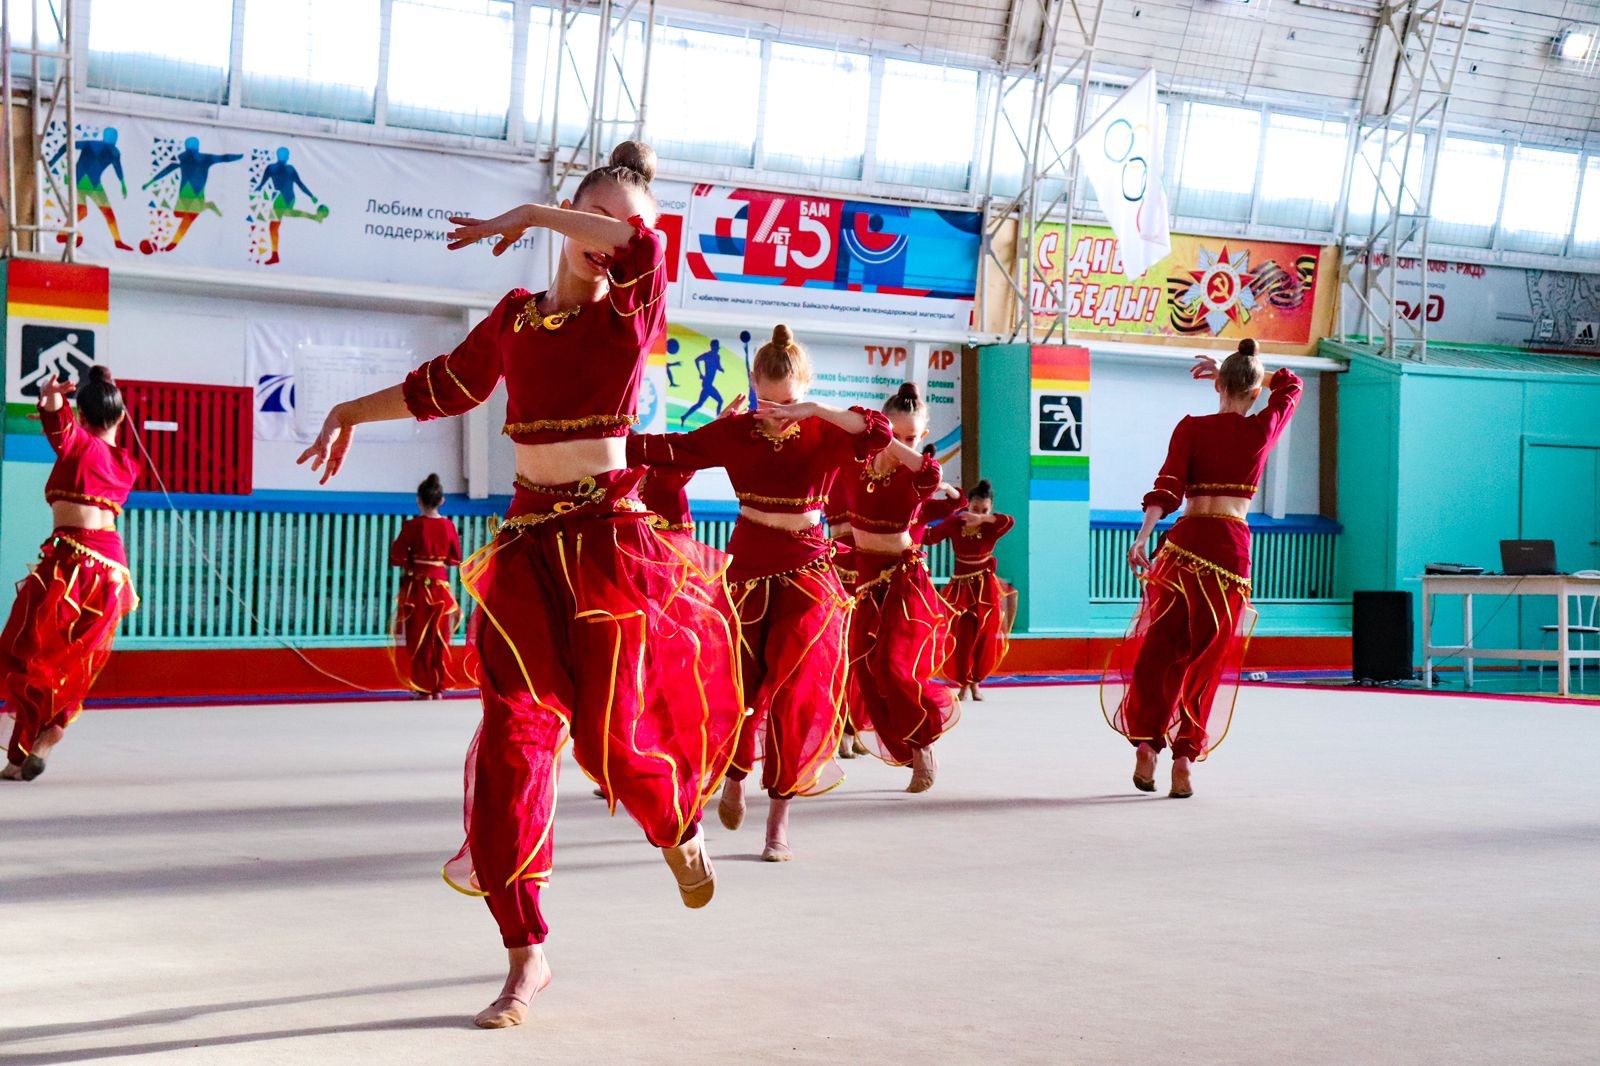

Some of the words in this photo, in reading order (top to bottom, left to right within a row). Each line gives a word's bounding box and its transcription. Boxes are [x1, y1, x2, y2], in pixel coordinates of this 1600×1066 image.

[366, 199, 423, 217] Любим
[800, 201, 831, 218] БАМ
[487, 234, 536, 251] спрт!
[766, 231, 792, 246] ЛЕТ
[1038, 232, 1059, 269] С
[1427, 260, 1448, 274] 009
[698, 294, 730, 303] юбилеем
[754, 299, 801, 308] строительства
[802, 301, 861, 313] Байкало-Амурской
[862, 307, 918, 317] железнодорожной
[1031, 279, 1162, 326] ПОБЕДЫ!
[864, 345, 955, 370] ТУРИР
[838, 371, 871, 384] бытового
[927, 380, 955, 390] селения
